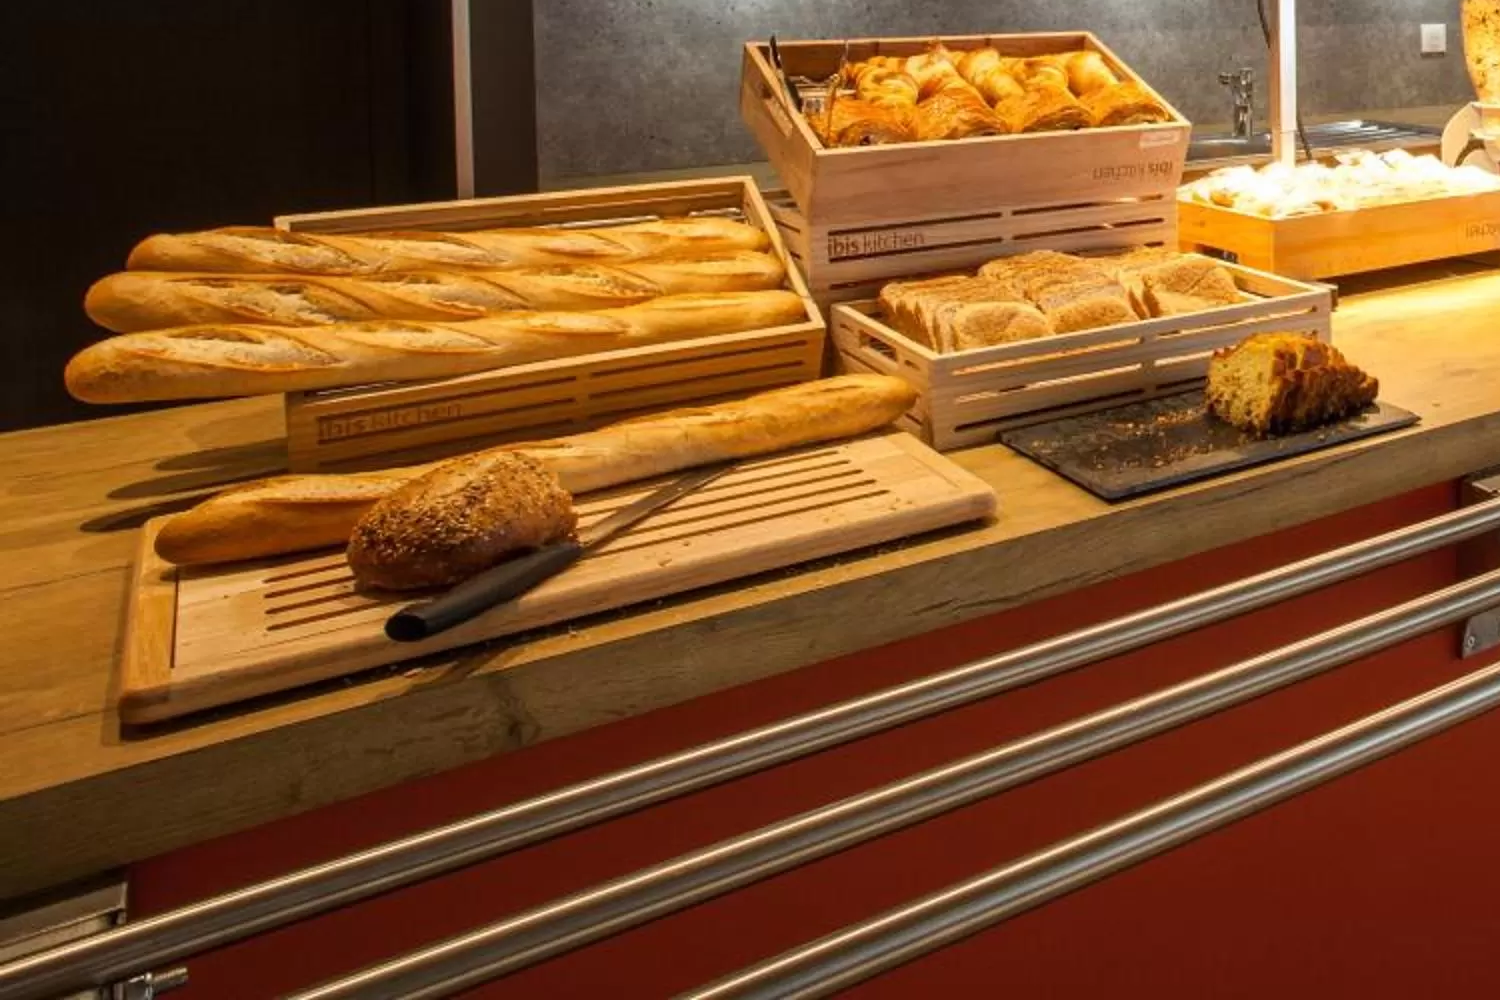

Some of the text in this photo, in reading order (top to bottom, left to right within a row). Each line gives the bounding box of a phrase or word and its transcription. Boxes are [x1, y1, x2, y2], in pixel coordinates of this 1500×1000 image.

[827, 231, 925, 257] ibis kitchen
[318, 405, 463, 440] ibis kitchen
